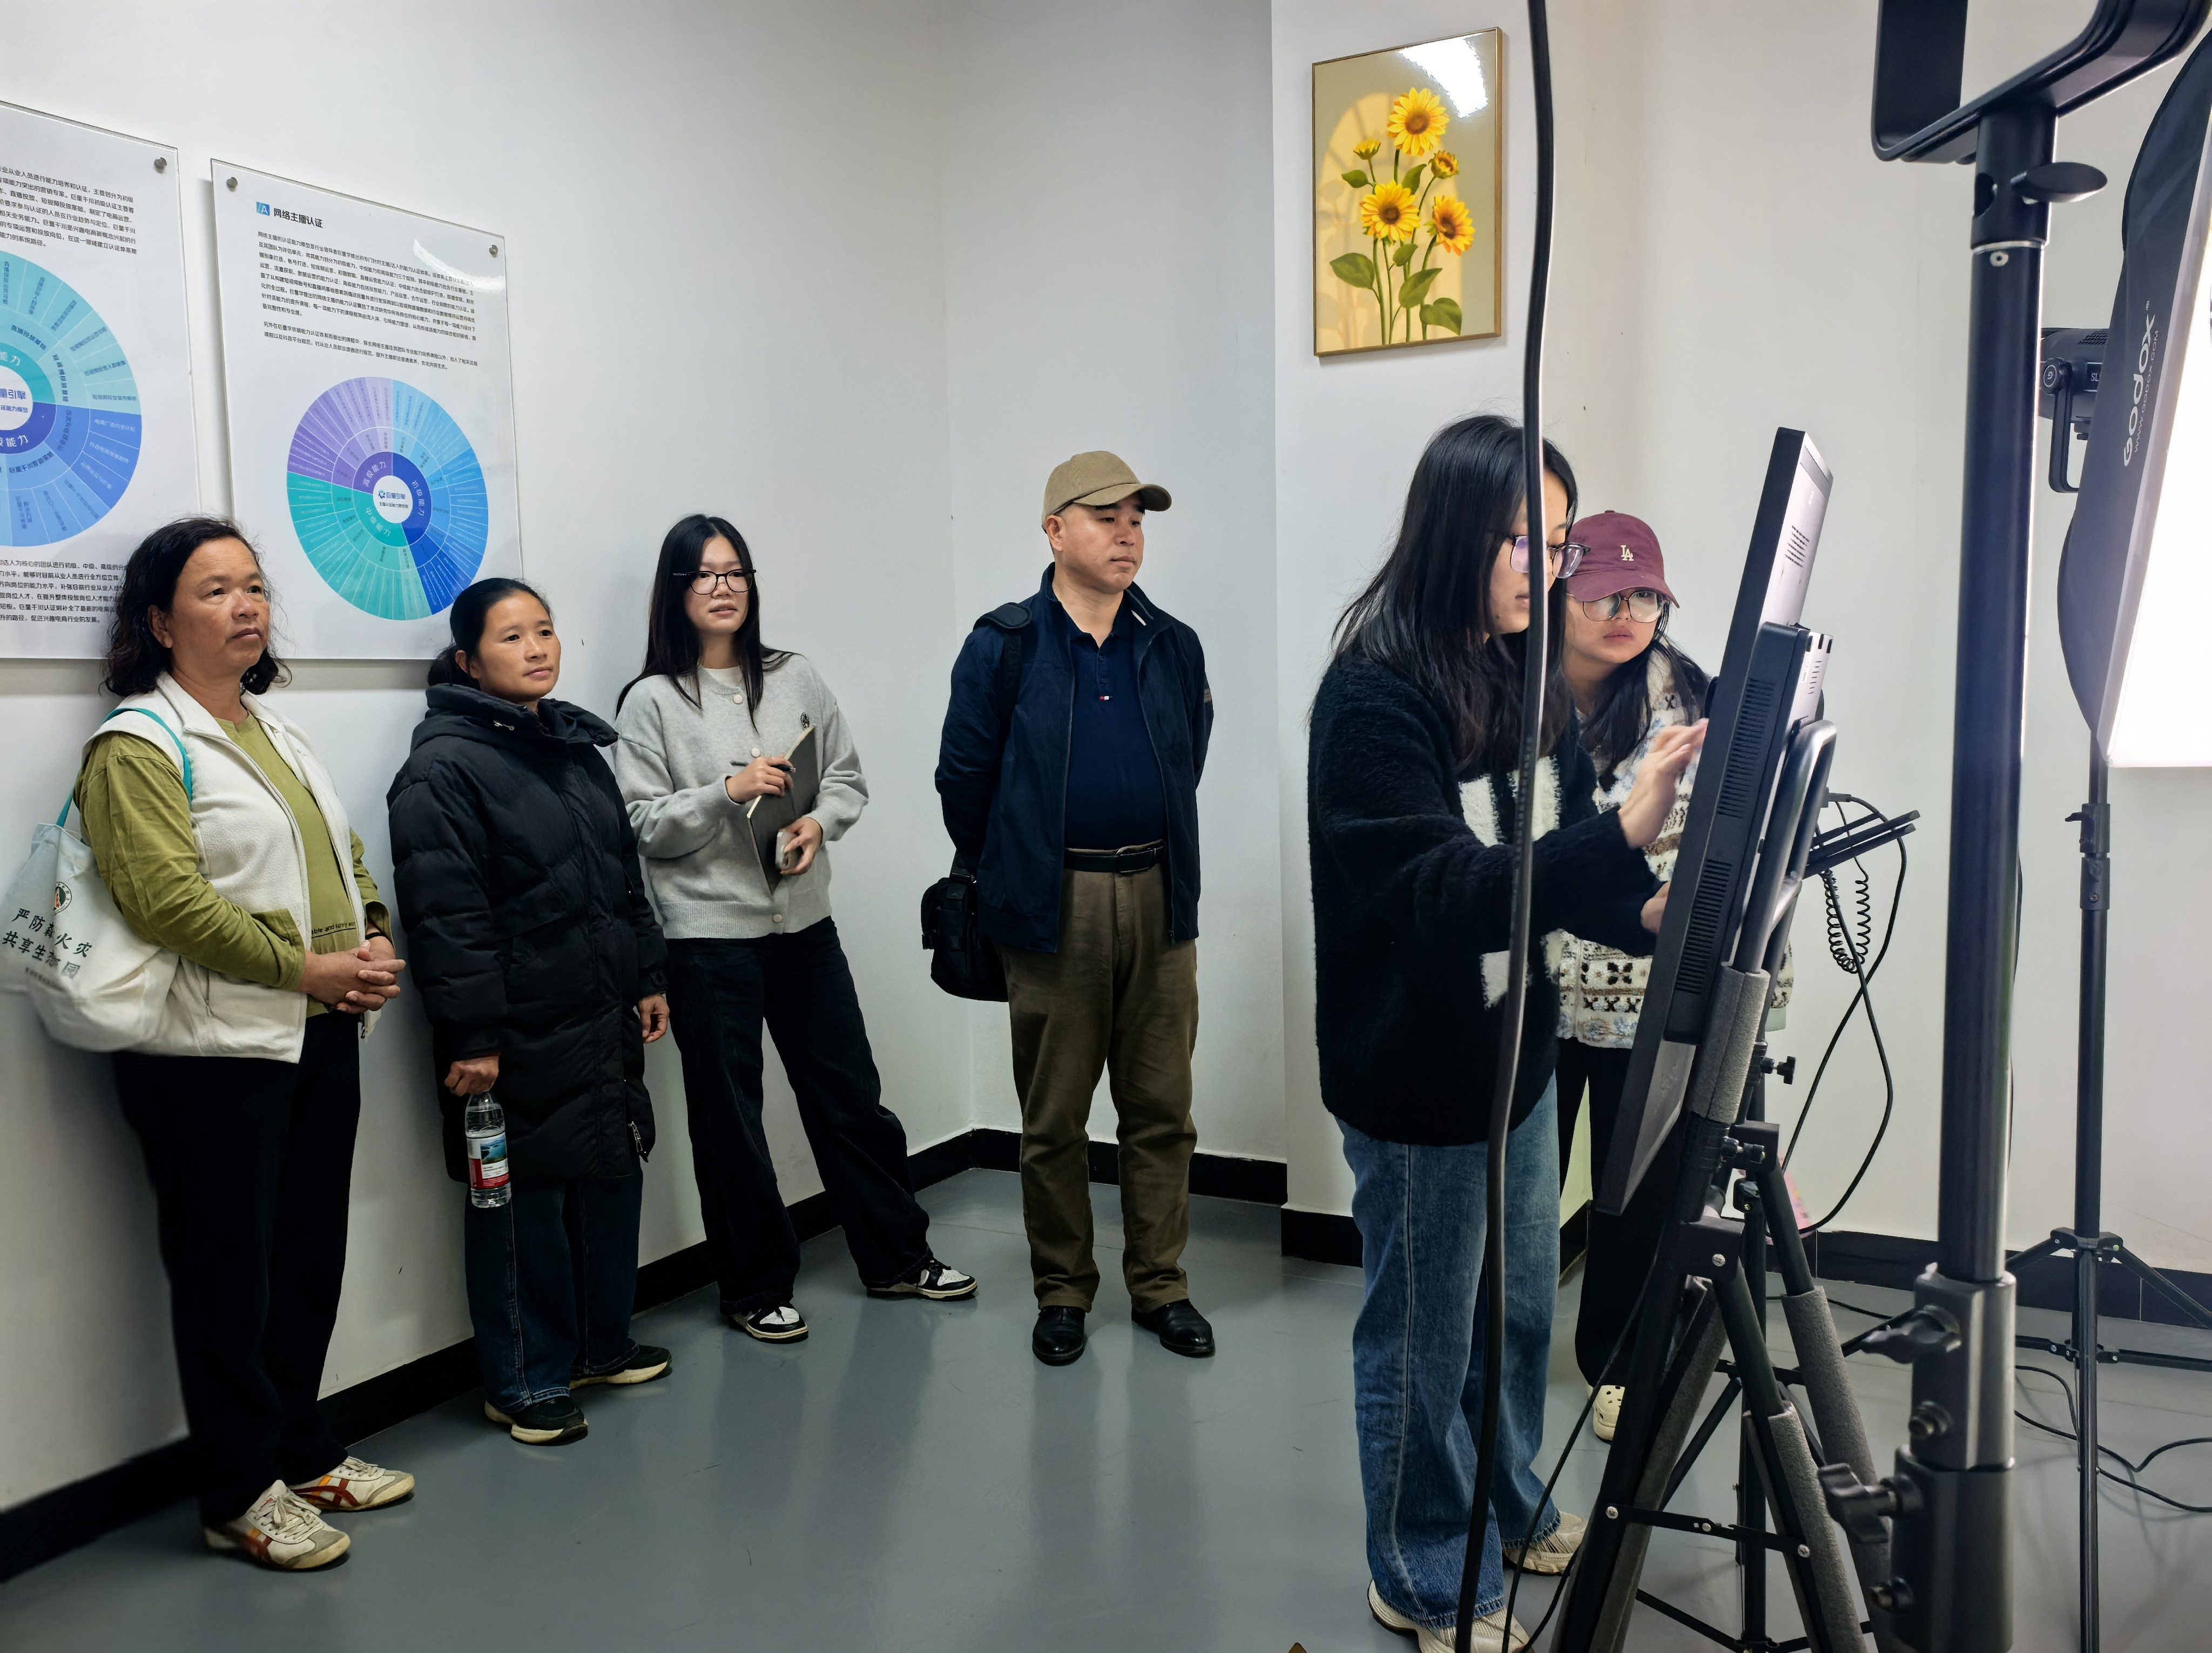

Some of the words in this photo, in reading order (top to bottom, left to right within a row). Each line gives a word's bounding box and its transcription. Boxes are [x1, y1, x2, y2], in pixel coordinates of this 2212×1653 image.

[274, 207, 323, 228] 网络主播认证
[362, 461, 387, 488] 高级能力
[411, 480, 425, 517] 初级能力
[1620, 544, 1634, 561] LA
[11, 907, 93, 958] 严防森火灾
